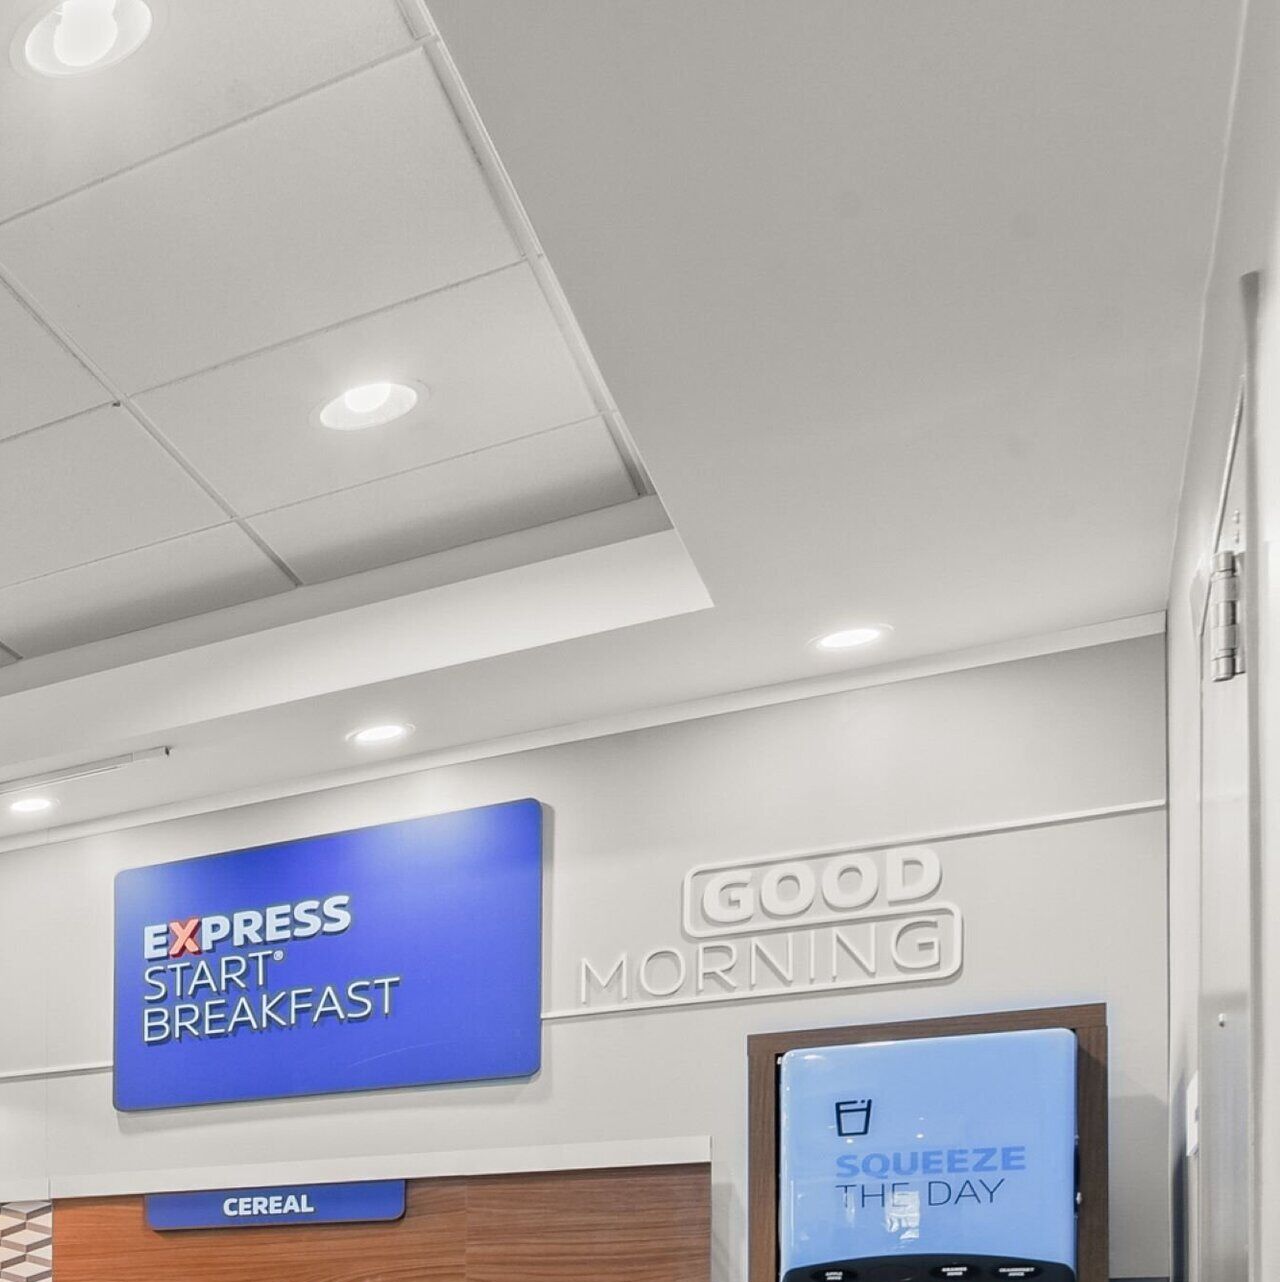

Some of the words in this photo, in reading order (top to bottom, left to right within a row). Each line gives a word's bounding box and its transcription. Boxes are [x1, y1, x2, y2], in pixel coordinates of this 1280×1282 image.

[702, 848, 942, 923] GOOD
[143, 895, 352, 960] EXPRESS
[580, 919, 941, 1005] MORNING
[143, 976, 401, 1042] BREAKFAST
[835, 1181, 911, 1209] THE
[927, 1178, 1006, 1207] DAY
[836, 1146, 1027, 1180] SQUEEZE
[223, 1194, 315, 1217] CEREAL
